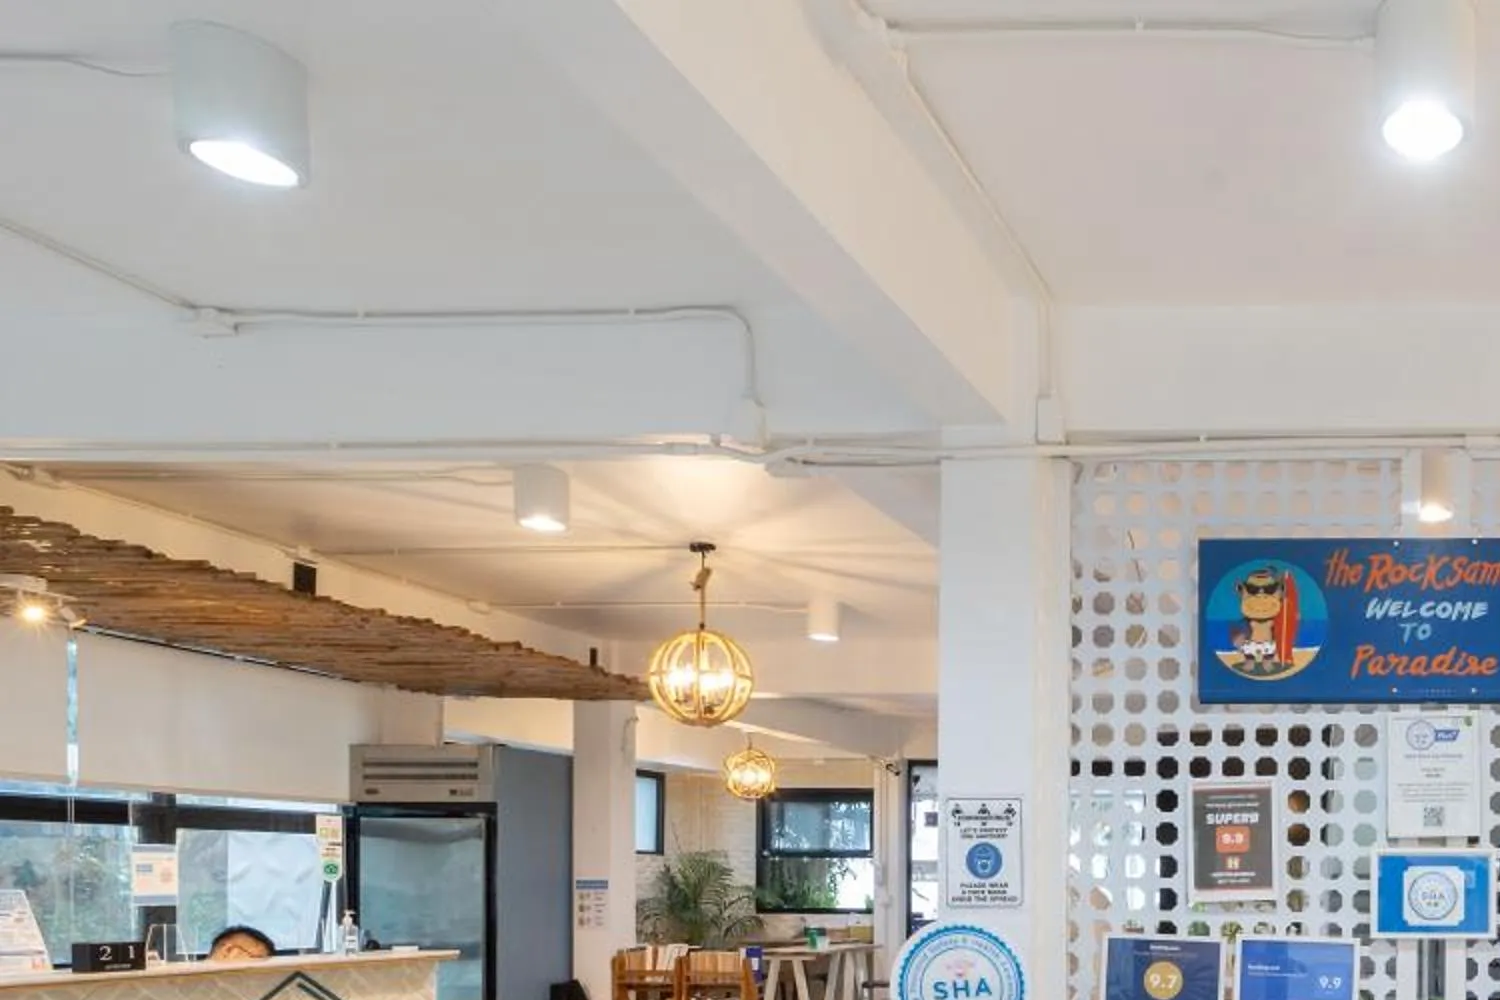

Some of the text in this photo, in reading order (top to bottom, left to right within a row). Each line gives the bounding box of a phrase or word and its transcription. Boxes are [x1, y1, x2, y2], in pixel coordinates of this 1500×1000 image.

[1366, 598, 1488, 621] WELCOME
[1400, 622, 1432, 644] TO
[1350, 644, 1498, 680] Paradise
[933, 977, 992, 1000] SHA
[1150, 974, 1178, 989] 9.7
[1319, 977, 1342, 989] 9.9
